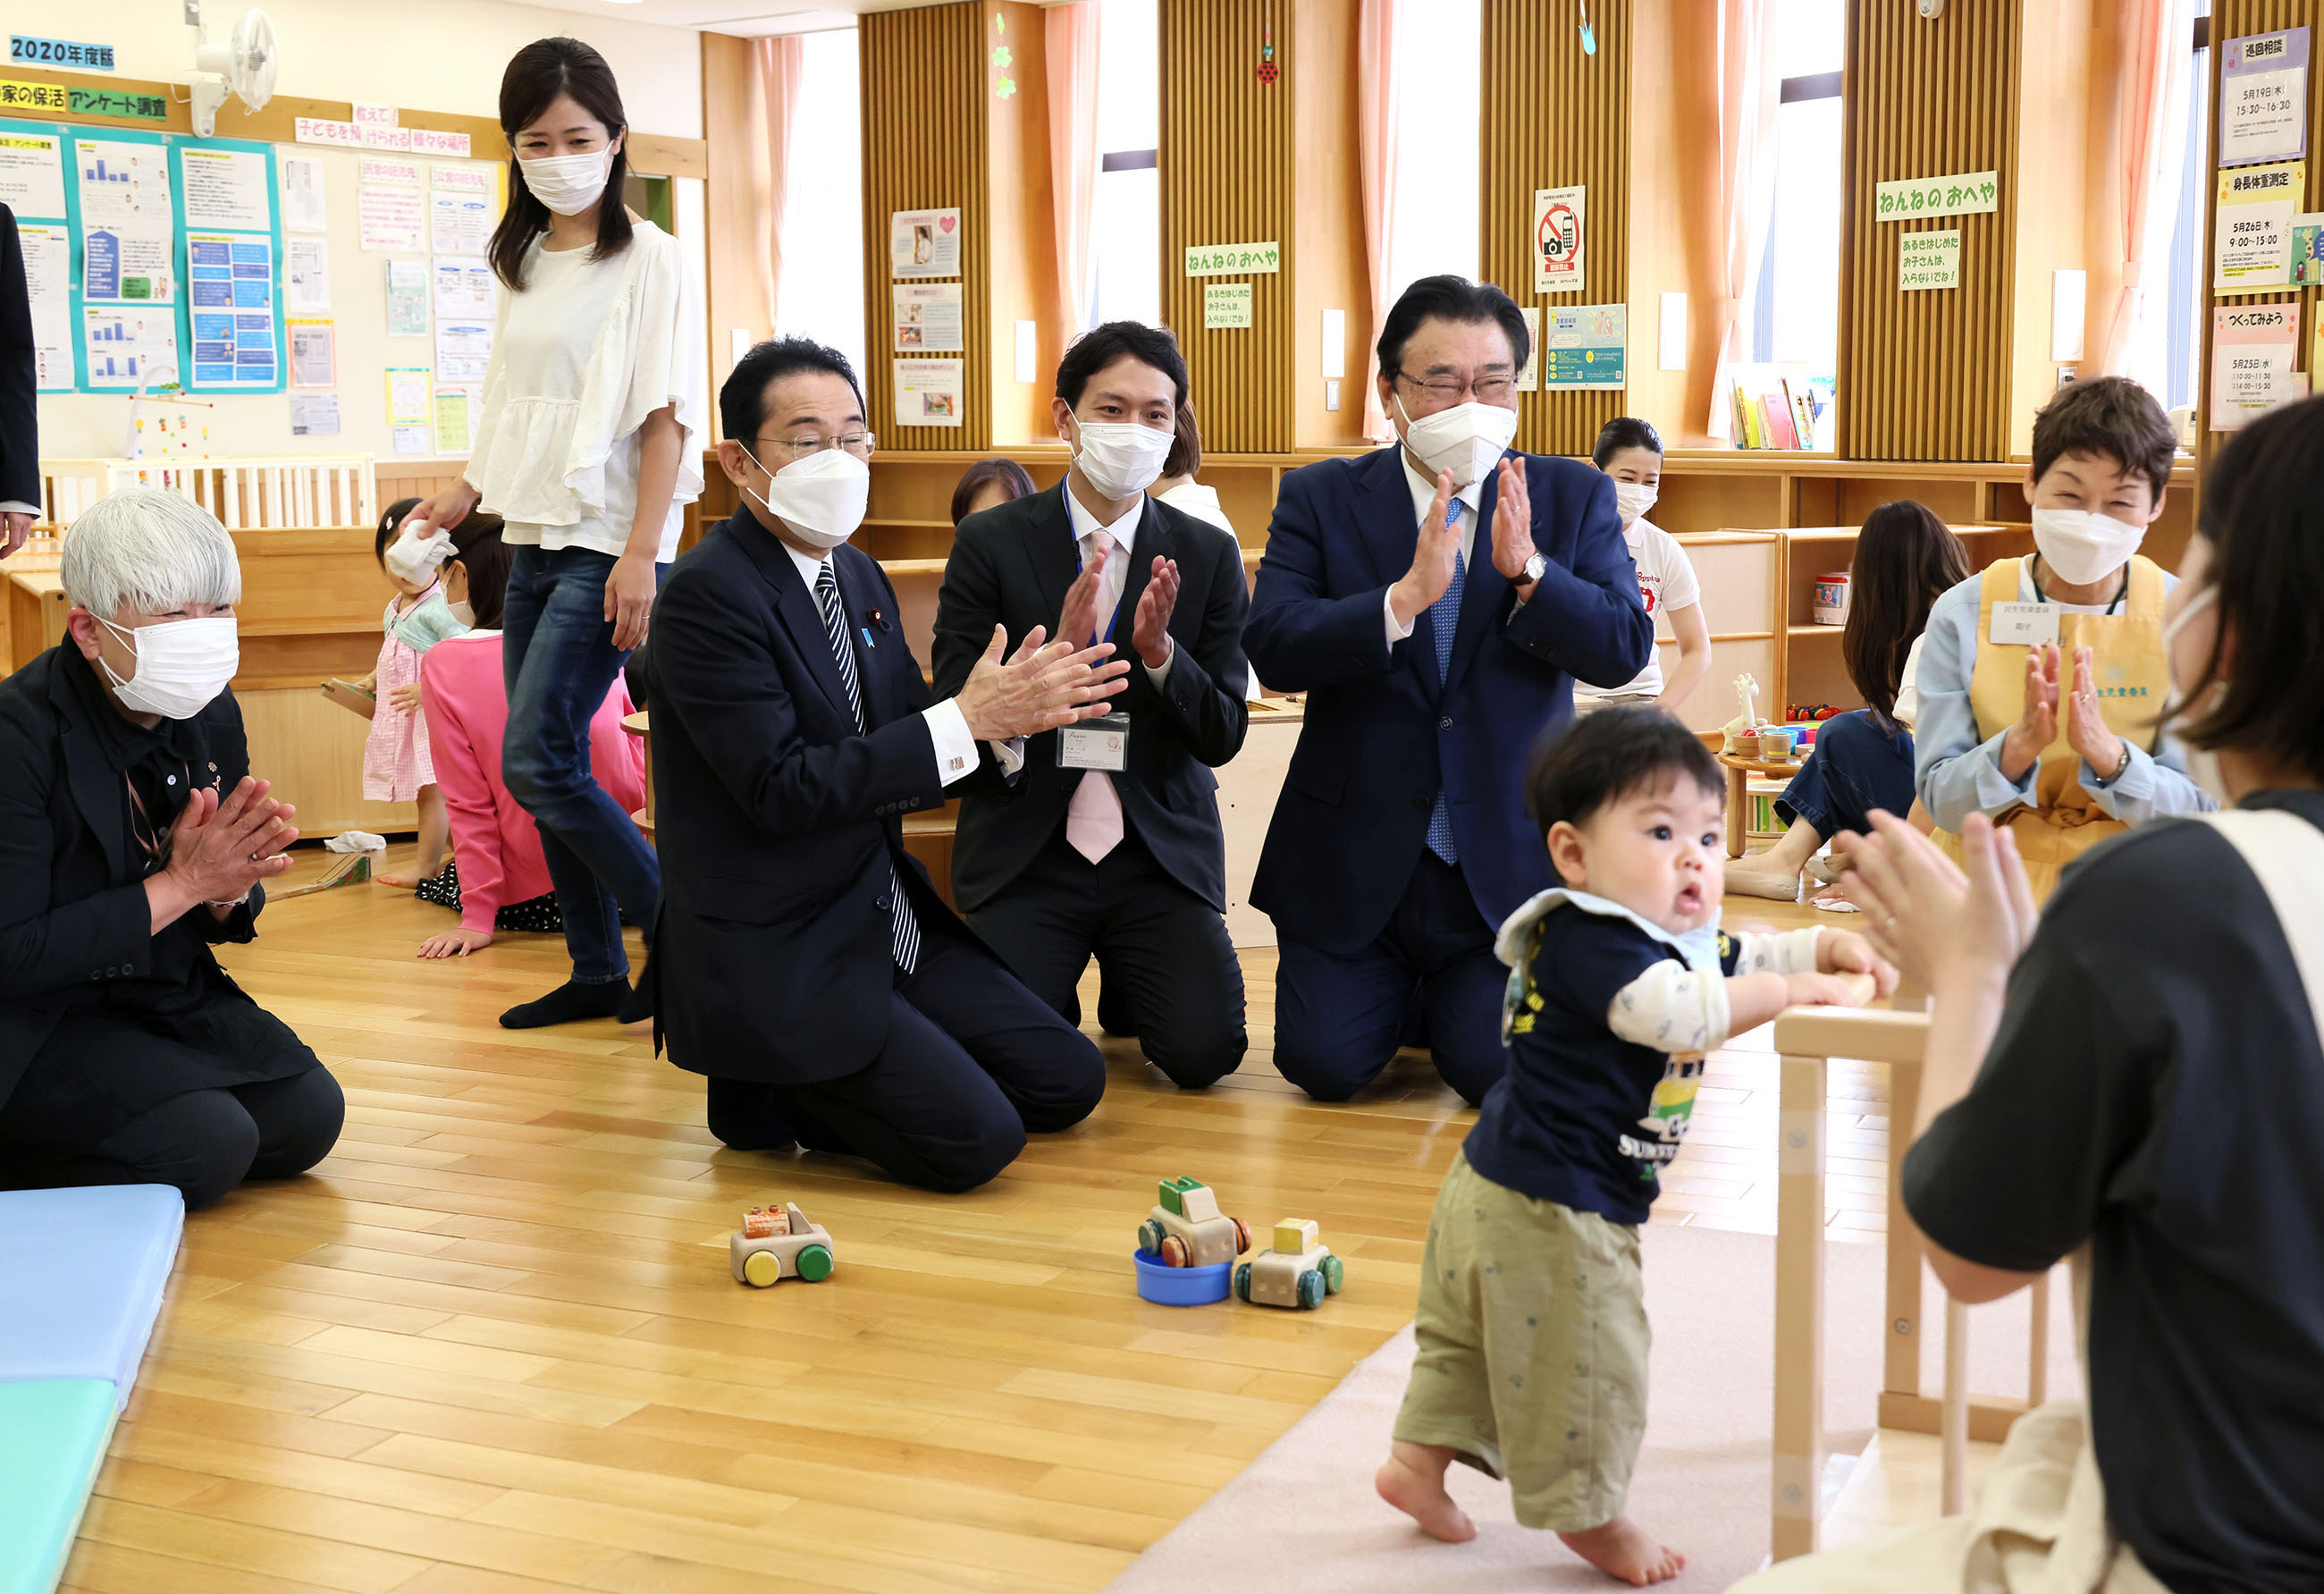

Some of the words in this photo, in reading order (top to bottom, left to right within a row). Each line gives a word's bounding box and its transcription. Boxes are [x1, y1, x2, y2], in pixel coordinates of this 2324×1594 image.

[12, 38, 114, 68] 2020年度版
[2245, 38, 2283, 58] 巡回相談
[3, 84, 64, 106] 家の保活
[69, 90, 166, 116] アンケート調査
[2233, 172, 2289, 191] 身長体重測定
[1880, 181, 1995, 213] ねんねのおへや
[1902, 237, 1958, 251] あるきはじめた
[1188, 250, 1277, 270] ねんねのおへや
[1207, 290, 1250, 298] あるきはじめた
[2228, 312, 2283, 326] つくってみよう
